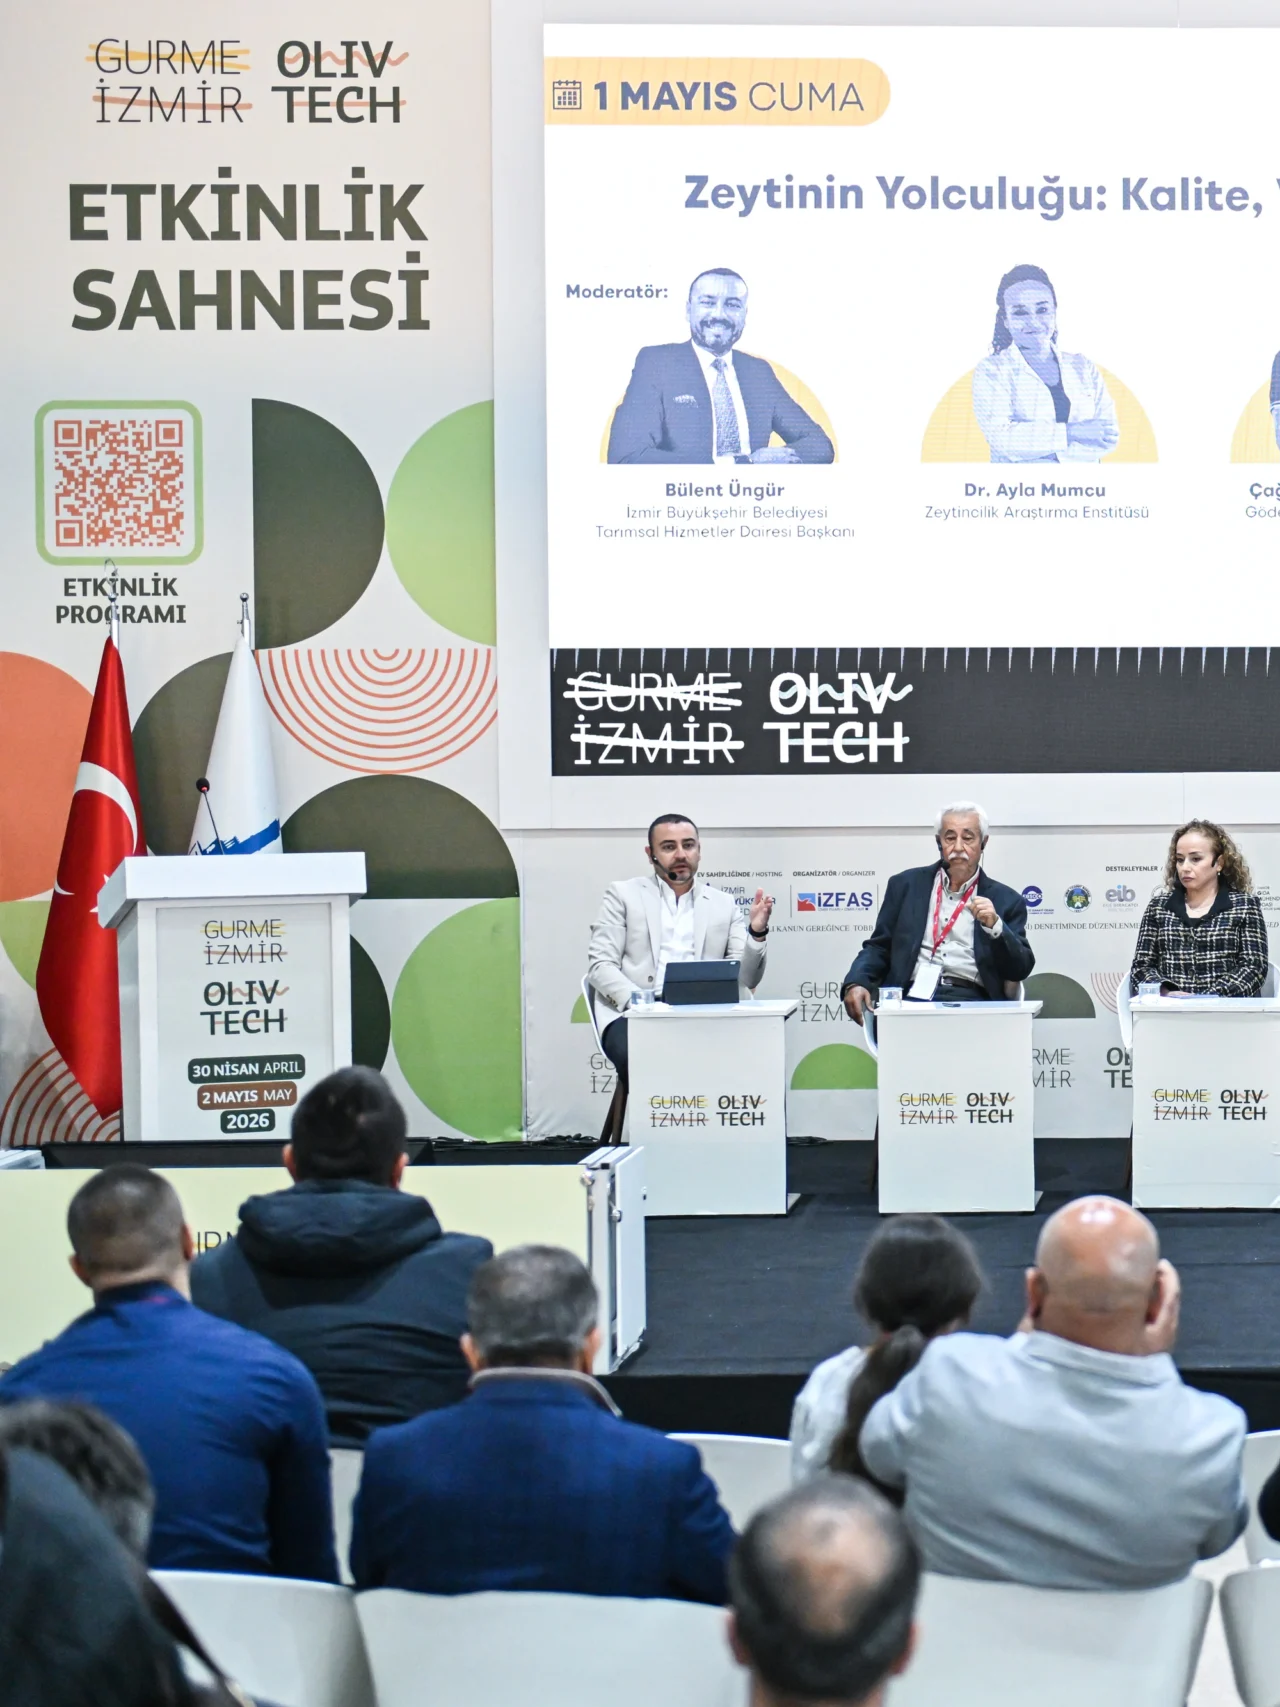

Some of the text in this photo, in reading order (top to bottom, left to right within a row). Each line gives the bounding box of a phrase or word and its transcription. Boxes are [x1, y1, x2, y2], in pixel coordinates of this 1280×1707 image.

[94, 38, 242, 75] GURME
[276, 40, 394, 79] OLIV
[95, 78, 244, 123] İZMİR
[271, 85, 401, 123] TECH
[594, 81, 865, 112] 1 MAYIS CUMA
[69, 166, 428, 241] ETKİNLİK
[684, 173, 864, 218] Zeytinin
[876, 174, 1107, 221] Yolculuğu:
[1122, 175, 1263, 218] Kalite,
[71, 251, 430, 332] SAHNESİ
[565, 284, 669, 300] Moderatör:
[665, 478, 785, 501] Bülent Üngür
[964, 482, 1106, 500] Dr. Ayla Mumcu
[626, 504, 828, 521] İzmir Büyükşehir Belediyesi
[925, 505, 1149, 521] Zeytincilik Araştırma Enstitüsü
[596, 525, 855, 540] Tarımsal Hizmetler Dairesi Başkanı
[63, 571, 178, 597] ETKİNLİK
[573, 671, 732, 711] GURME
[769, 671, 897, 715] OLIV
[573, 715, 735, 765] İZMİR
[763, 721, 903, 764] TECH
[1105, 884, 1136, 902] eib
[204, 918, 282, 940] GURME
[204, 941, 284, 966] İZMİR
[203, 980, 281, 1006] OLIV
[200, 1009, 286, 1035] TECH
[192, 1060, 302, 1078] 30 NİSAN APRIL
[202, 1088, 293, 1104] 2 MAYIS MAY
[650, 1095, 705, 1109] GURME
[718, 1095, 762, 1109] OLIV
[899, 1092, 954, 1107] GURME
[966, 1092, 1010, 1107] OLIV
[1153, 1088, 1208, 1102] GURME
[1220, 1089, 1264, 1104] OLIV
[650, 1112, 706, 1127] İZMİR
[716, 1112, 764, 1126] TECH
[900, 1107, 955, 1124] İZMİR
[965, 1109, 1012, 1124] TECH
[1154, 1102, 1208, 1120] İZMİR
[1218, 1105, 1266, 1120] TECH
[227, 1113, 270, 1129] 2026
